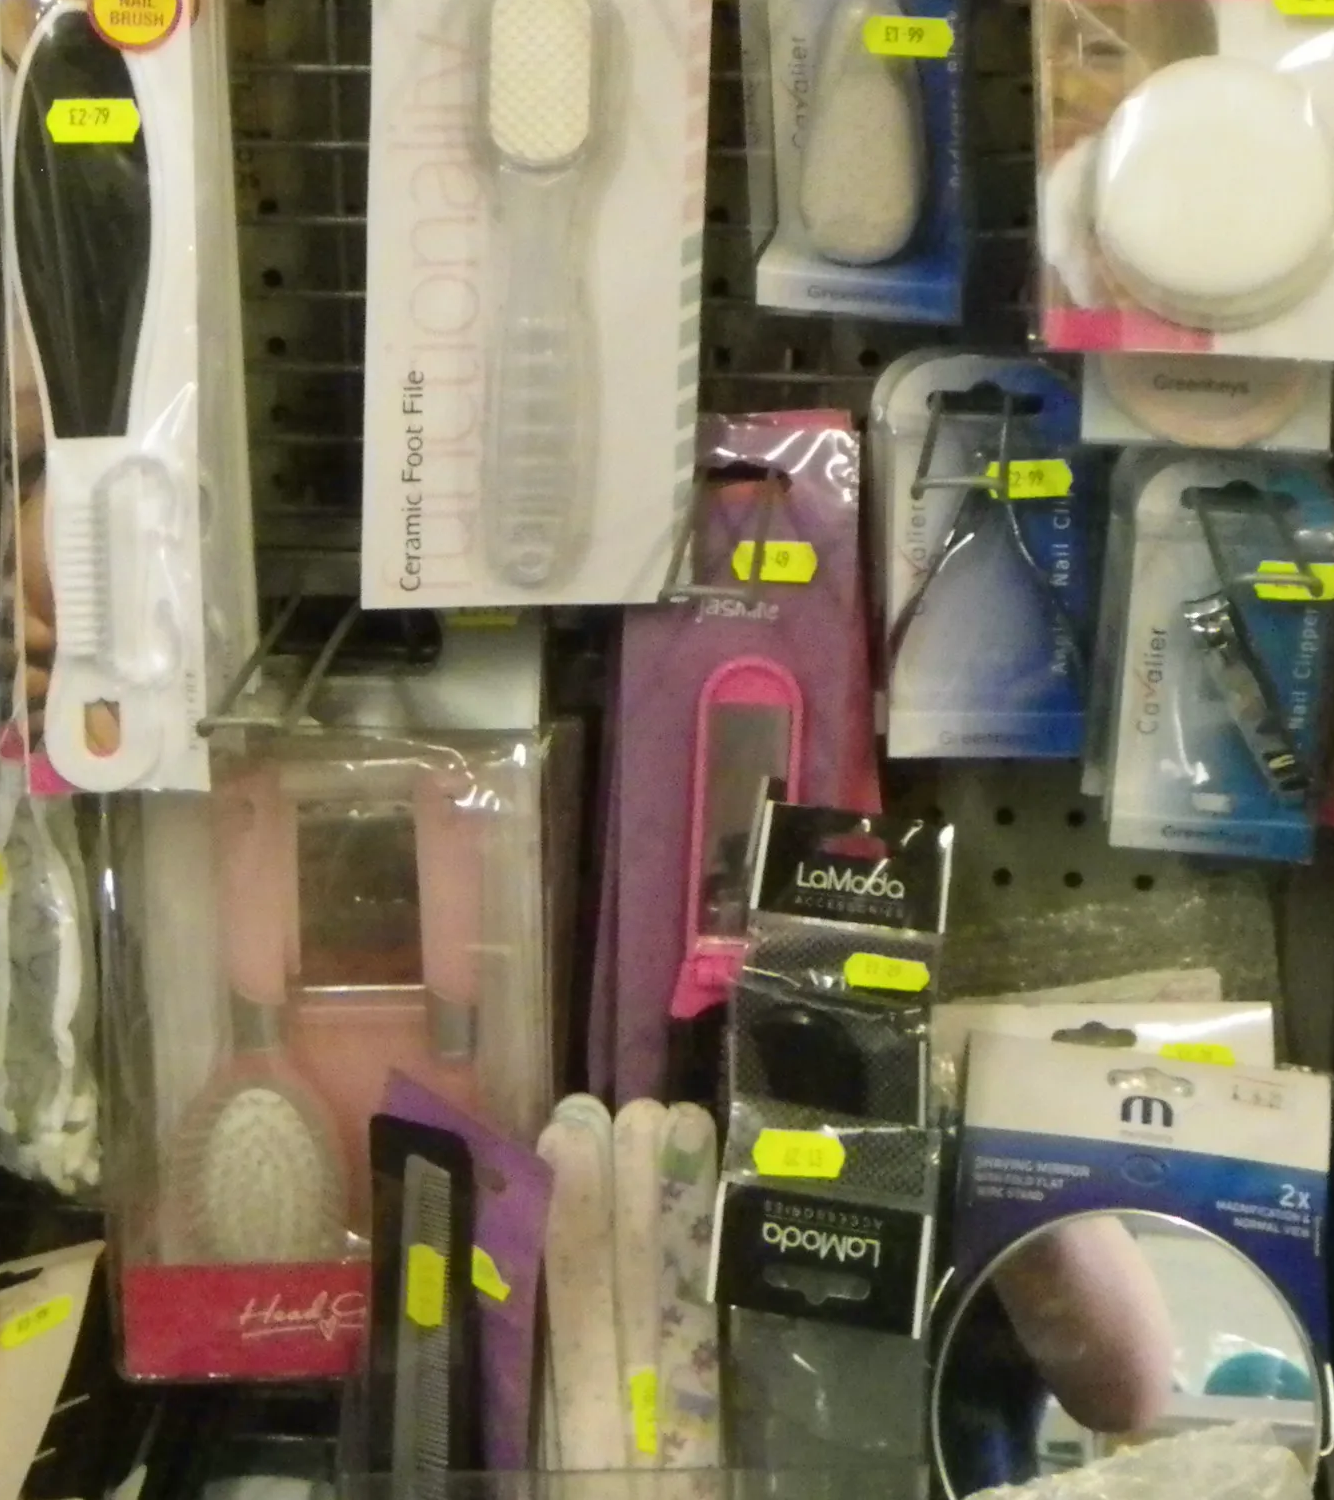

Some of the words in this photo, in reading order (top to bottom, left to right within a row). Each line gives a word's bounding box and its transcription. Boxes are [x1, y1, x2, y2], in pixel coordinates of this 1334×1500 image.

[109, 10, 165, 28] BRUSH
[68, 107, 111, 128] £2.79
[400, 370, 425, 416] File
[400, 424, 425, 484] Foot
[400, 493, 427, 592] Ceramic
[1051, 544, 1070, 587] Nail
[1294, 607, 1318, 680] Clipper
[1135, 626, 1168, 736] Cavalier
[1288, 684, 1312, 734] Nail
[795, 862, 906, 900] LaModa
[761, 1221, 882, 1268] LaModa
